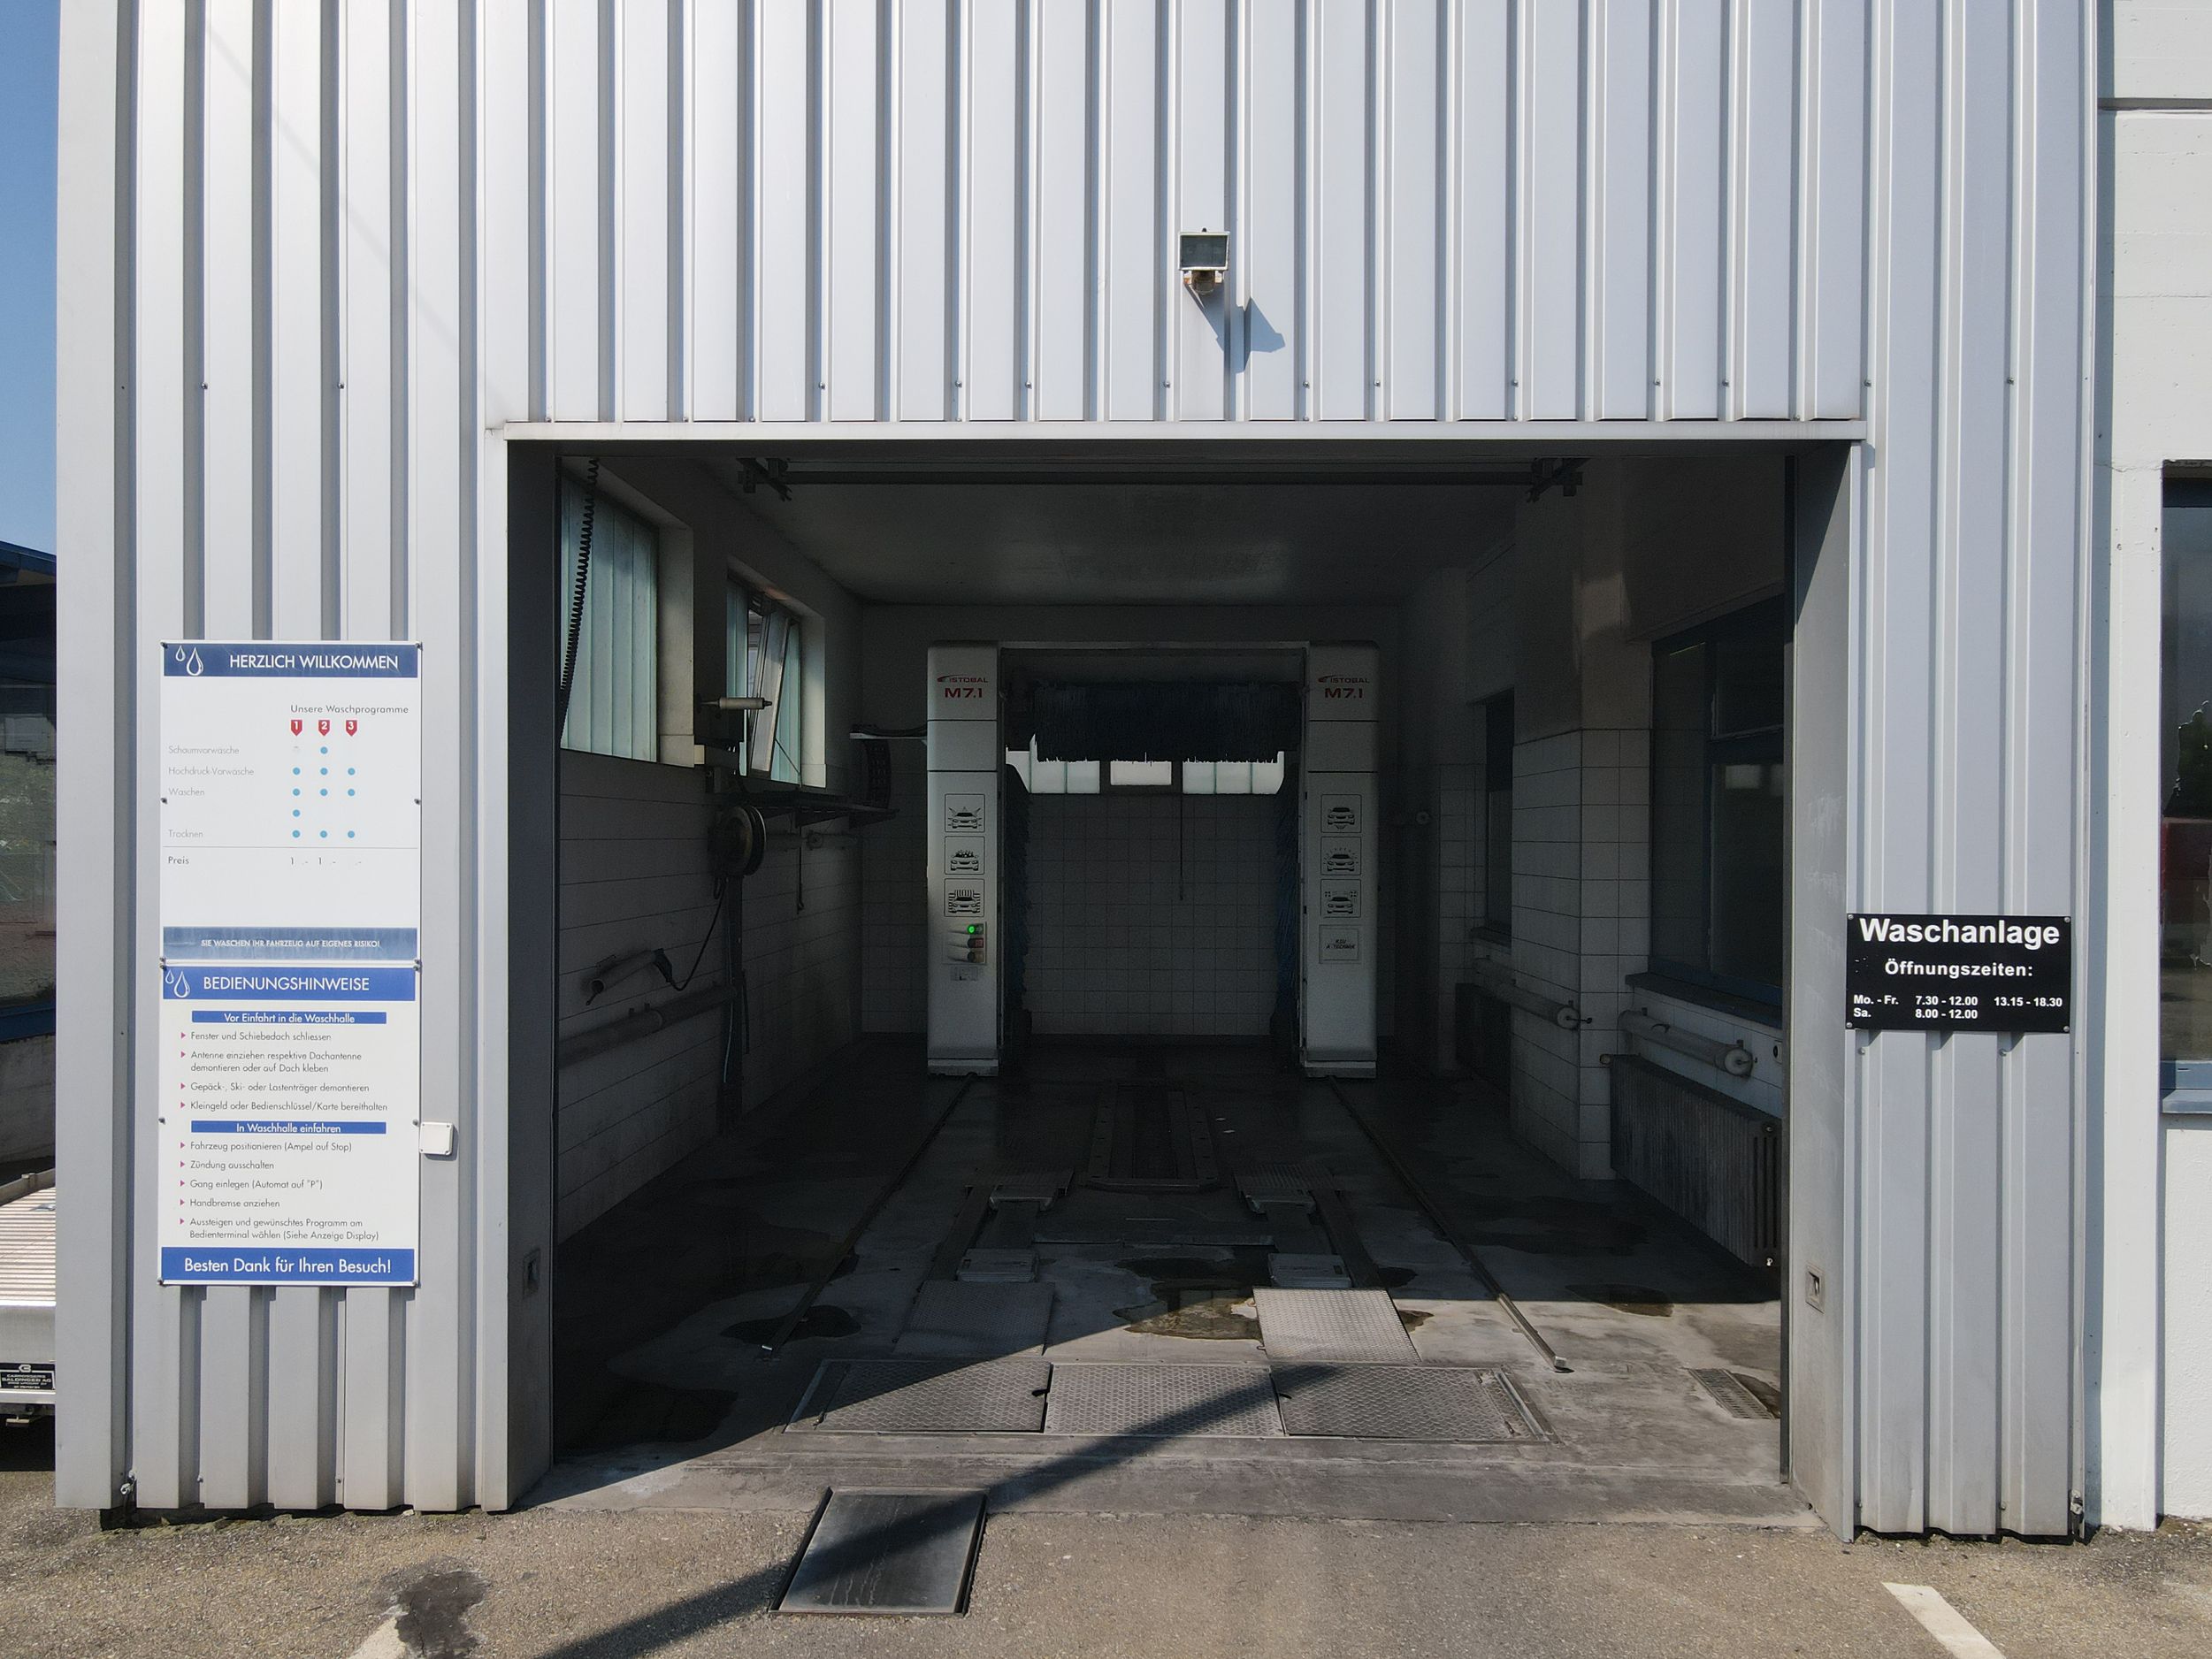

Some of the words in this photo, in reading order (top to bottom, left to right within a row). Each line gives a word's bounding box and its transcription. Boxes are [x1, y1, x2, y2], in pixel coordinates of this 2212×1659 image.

[230, 654, 295, 669] HERZLICH
[299, 654, 398, 669] WILLKOMMEN
[945, 688, 982, 698] M7.1
[290, 704, 323, 714] Unsere
[325, 705, 409, 715] Waschprogramme
[294, 722, 299, 730] 1
[321, 722, 327, 730] 2
[348, 722, 354, 730] 3
[168, 787, 205, 796] Waschen
[168, 830, 203, 838] Trocknen
[168, 856, 189, 865] Preis
[1859, 918, 2060, 950] Waschanlage
[213, 939, 251, 948] WASCHEN
[1885, 958, 2033, 979] Öffnungszeiten:
[203, 976, 370, 991] BEDIENUNGSHINWEISE
[1854, 995, 1874, 1004] Mo.
[1884, 995, 1899, 1005] Fr.
[1916, 996, 1939, 1005] 7.30
[1948, 996, 1978, 1005] 12.00
[1994, 997, 2023, 1006] 13.15
[2033, 997, 2063, 1007] 18.30
[225, 1013, 240, 1022] Vor
[241, 1013, 276, 1022] Einfahrt
[278, 1013, 287, 1022] in
[288, 1013, 302, 1023] die
[304, 1014, 355, 1024] Waschhalle
[1854, 1008, 1871, 1017] Sa.
[1916, 1009, 1938, 1018] 8.00
[1948, 1010, 1978, 1019] 12.00
[191, 1031, 219, 1040] Fenster
[239, 1032, 290, 1041] Schiebedach
[292, 1033, 331, 1042] schliessen
[191, 1051, 225, 1059] Antenne
[226, 1051, 265, 1059] einziehen
[267, 1051, 307, 1063] respektive
[191, 1063, 241, 1072] demontieren
[279, 1064, 301, 1073] Dach
[269, 1083, 317, 1094] Lastenträger
[190, 1102, 228, 1112] Kleingeld
[230, 1102, 249, 1111] oder
[341, 1103, 387, 1112] bereithalten
[236, 1123, 245, 1132] In
[248, 1124, 297, 1134] Waschhalle
[299, 1124, 341, 1134] einfahren
[190, 1142, 228, 1152] Fahrzeug
[230, 1143, 283, 1152] positionieren
[285, 1143, 313, 1153] (Ampel
[316, 1143, 330, 1151] auf
[331, 1143, 352, 1153] Stop)
[190, 1160, 226, 1171] Zündung
[228, 1161, 274, 1170] ausschalten
[190, 1180, 214, 1190] Gang
[216, 1180, 249, 1190] einlegen
[251, 1180, 288, 1190] (Automat
[190, 1199, 241, 1208] Handbremse
[243, 1199, 279, 1208] anziehen
[189, 1219, 233, 1227] Aussteigen
[253, 1219, 304, 1228] gewünschtes
[306, 1219, 348, 1229] Programm
[189, 1231, 249, 1240] Bedienterminal
[251, 1231, 281, 1240] wählen
[283, 1231, 308, 1241] (Siehe
[346, 1231, 379, 1242] Display)
[184, 1258, 228, 1272] Besten
[233, 1258, 271, 1273] Dank
[276, 1258, 295, 1273] für
[299, 1258, 333, 1273] Ihren
[339, 1259, 391, 1273] Besuch!
